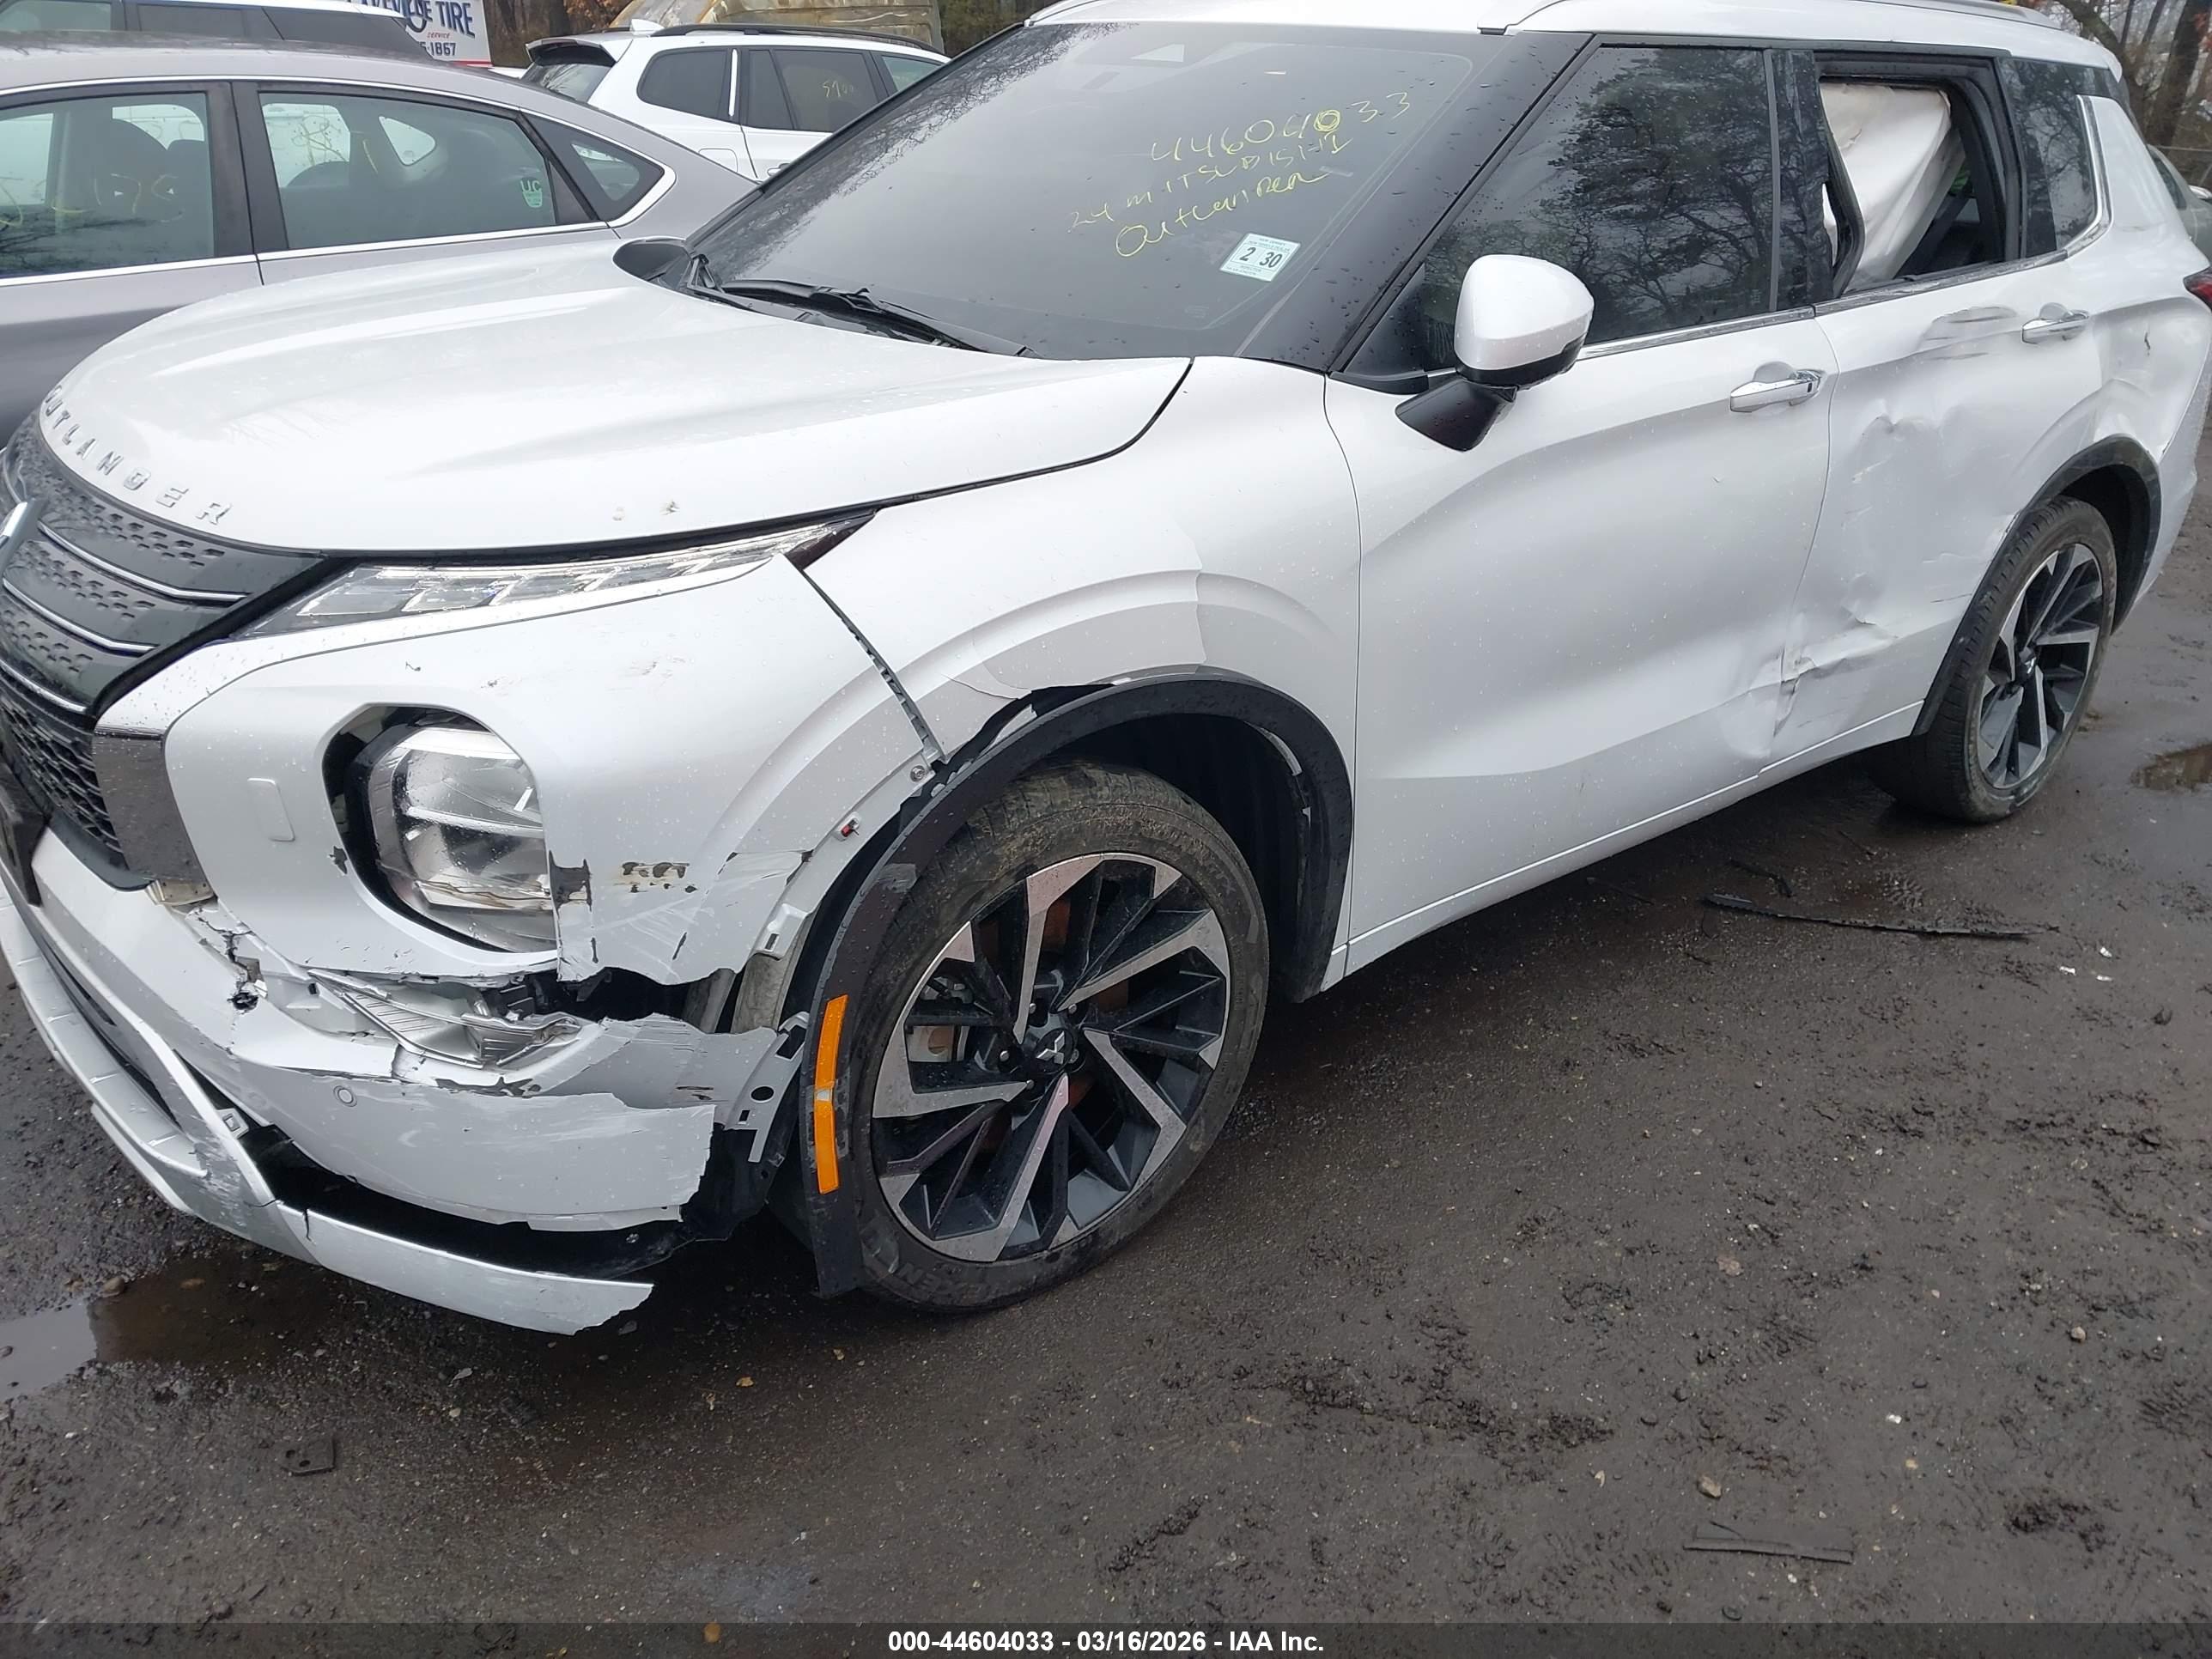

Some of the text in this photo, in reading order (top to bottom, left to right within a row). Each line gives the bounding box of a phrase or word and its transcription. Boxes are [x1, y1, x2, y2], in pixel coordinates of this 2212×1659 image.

[435, 2, 475, 39] TIRE
[1152, 92, 1410, 161] 44604033
[1239, 246, 1283, 268] 2 30
[45, 385, 233, 526] OUTLANDER
